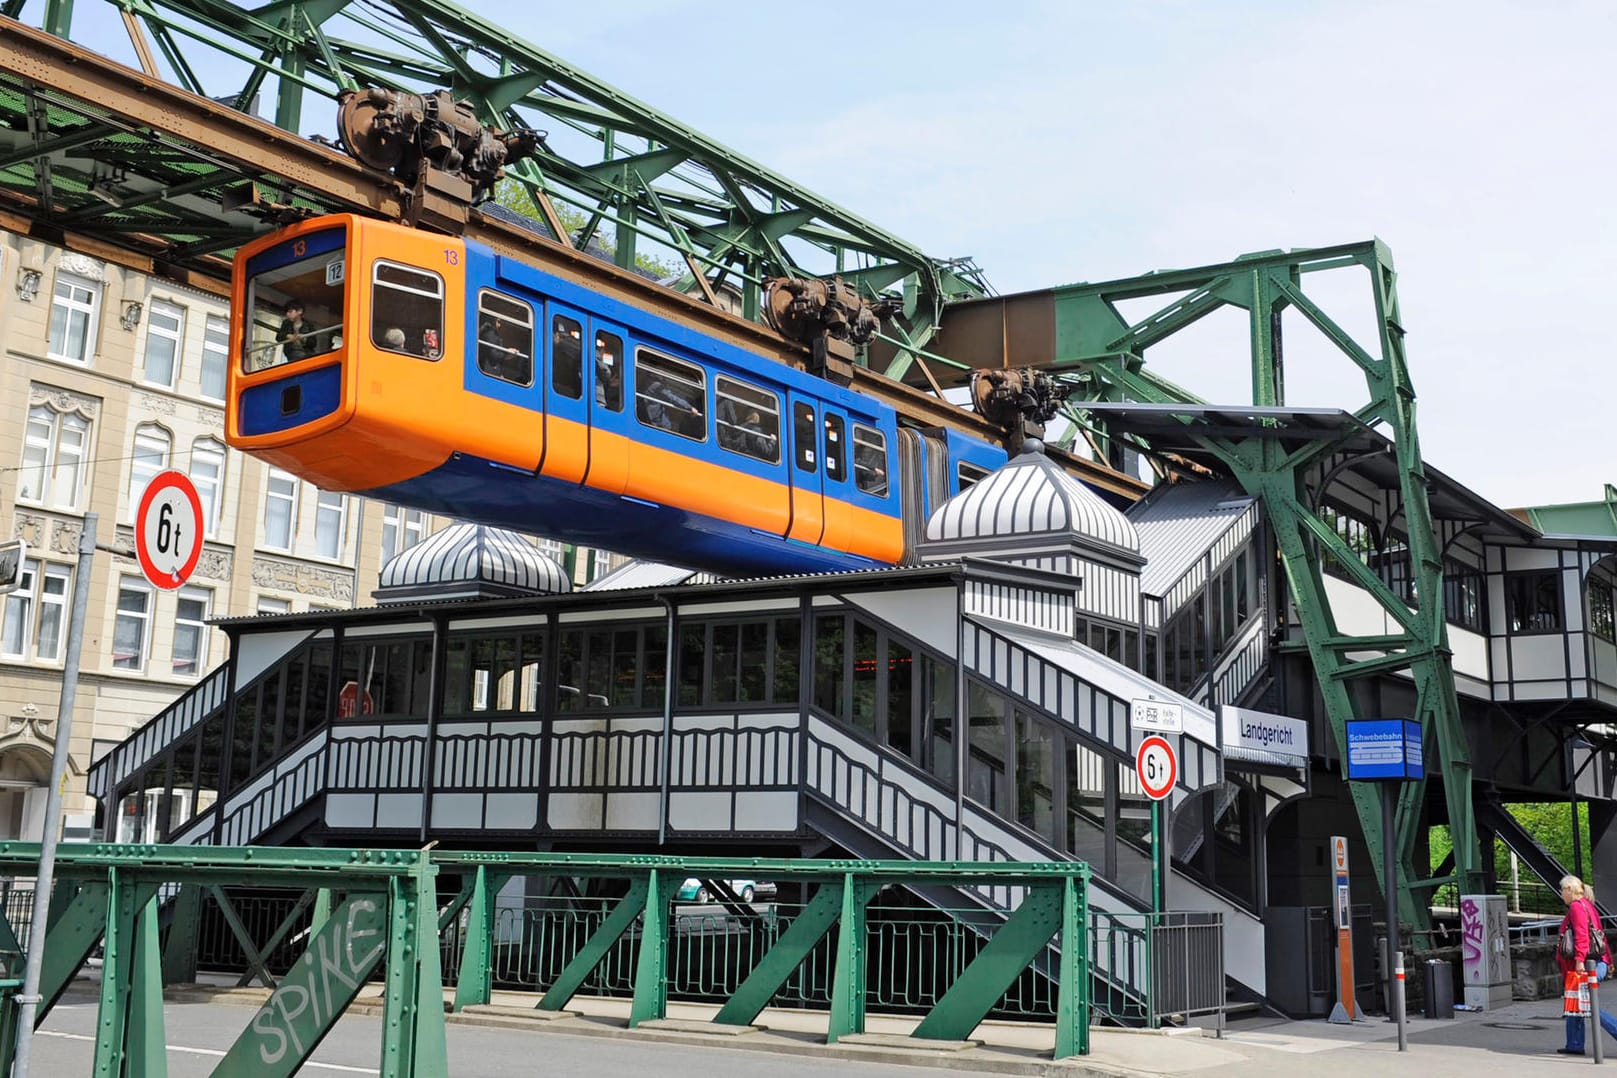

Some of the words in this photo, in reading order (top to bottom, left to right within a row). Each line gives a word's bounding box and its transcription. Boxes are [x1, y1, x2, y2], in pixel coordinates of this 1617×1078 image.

[292, 240, 306, 257] 13
[444, 250, 458, 265] 13
[331, 264, 342, 280] 12
[1240, 718, 1293, 746] Landgericht
[1349, 732, 1402, 741] Schwebebahn
